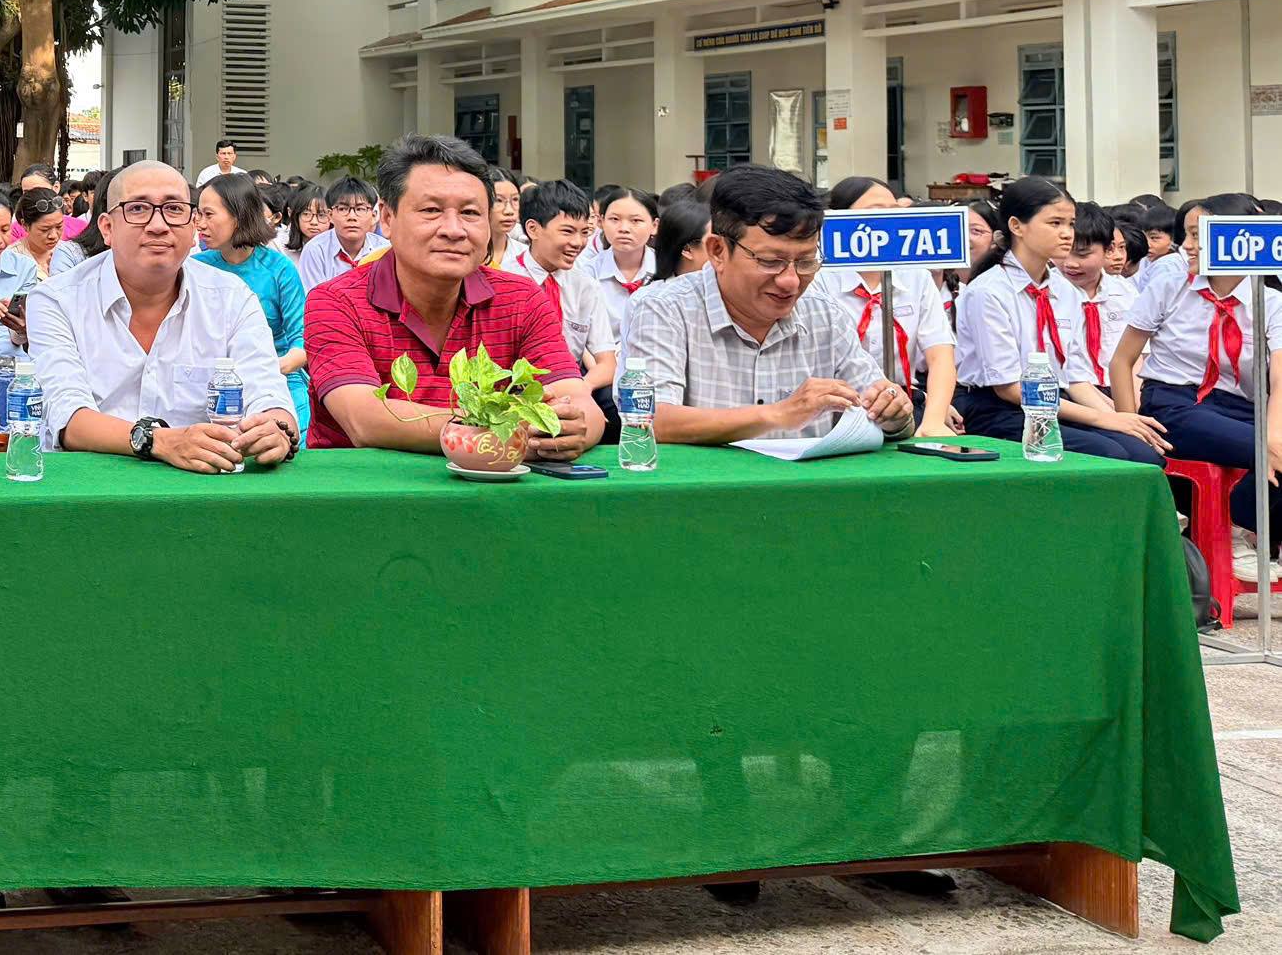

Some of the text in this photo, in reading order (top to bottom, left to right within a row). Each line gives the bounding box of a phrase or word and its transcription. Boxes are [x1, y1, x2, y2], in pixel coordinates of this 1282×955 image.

[833, 223, 952, 258] LỚP 7A1
[1218, 228, 1265, 262] LỚP
